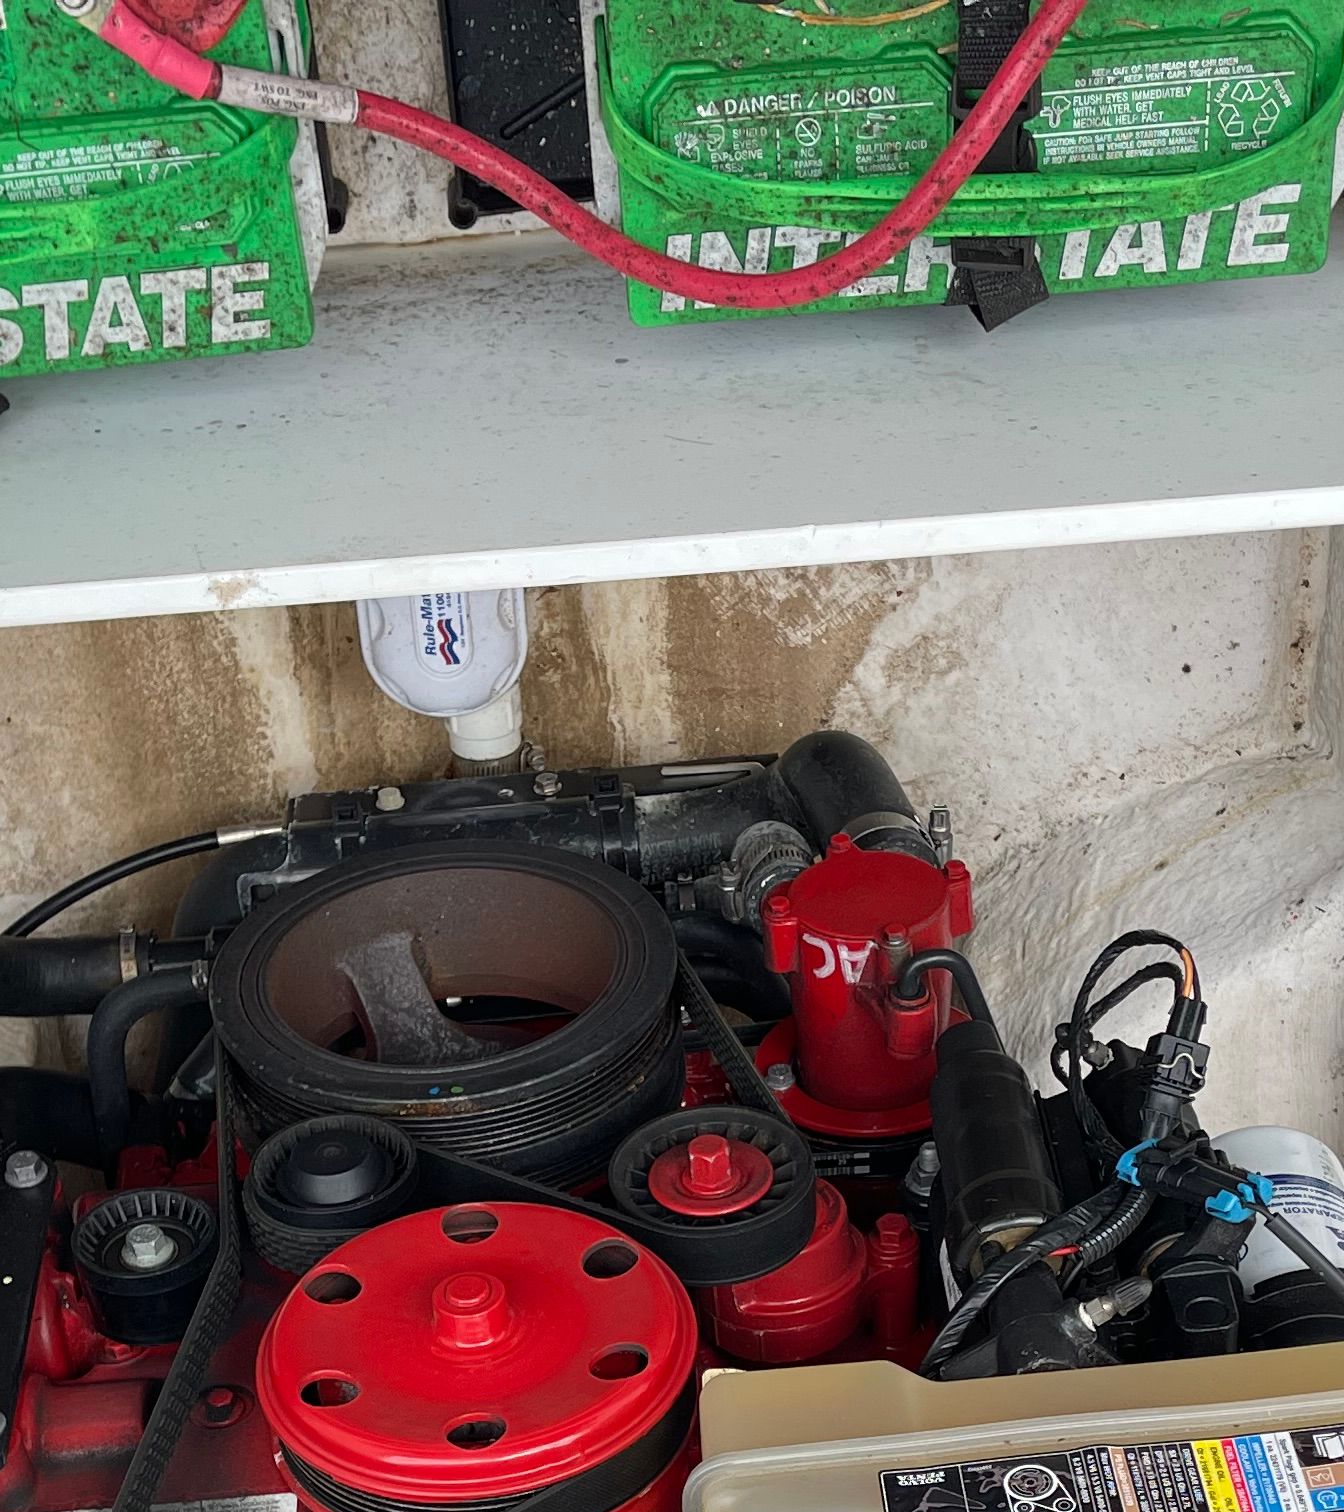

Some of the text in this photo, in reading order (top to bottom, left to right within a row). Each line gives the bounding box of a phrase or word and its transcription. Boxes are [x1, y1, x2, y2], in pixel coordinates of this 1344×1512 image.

[723, 85, 897, 114] DANGER POISON
[1071, 86, 1193, 105] FLUSH EYES IMMEDIATELY
[1072, 105, 1095, 116] WITH
[1135, 100, 1153, 111] GET
[1072, 116, 1111, 128] MEDICAL
[1141, 111, 1164, 122] FAST
[5, 169, 122, 190] FLUSH EYES IMMEDIATELY
[660, 184, 1303, 312] INTERTATE
[420, 594, 436, 654] Rule-Mat
